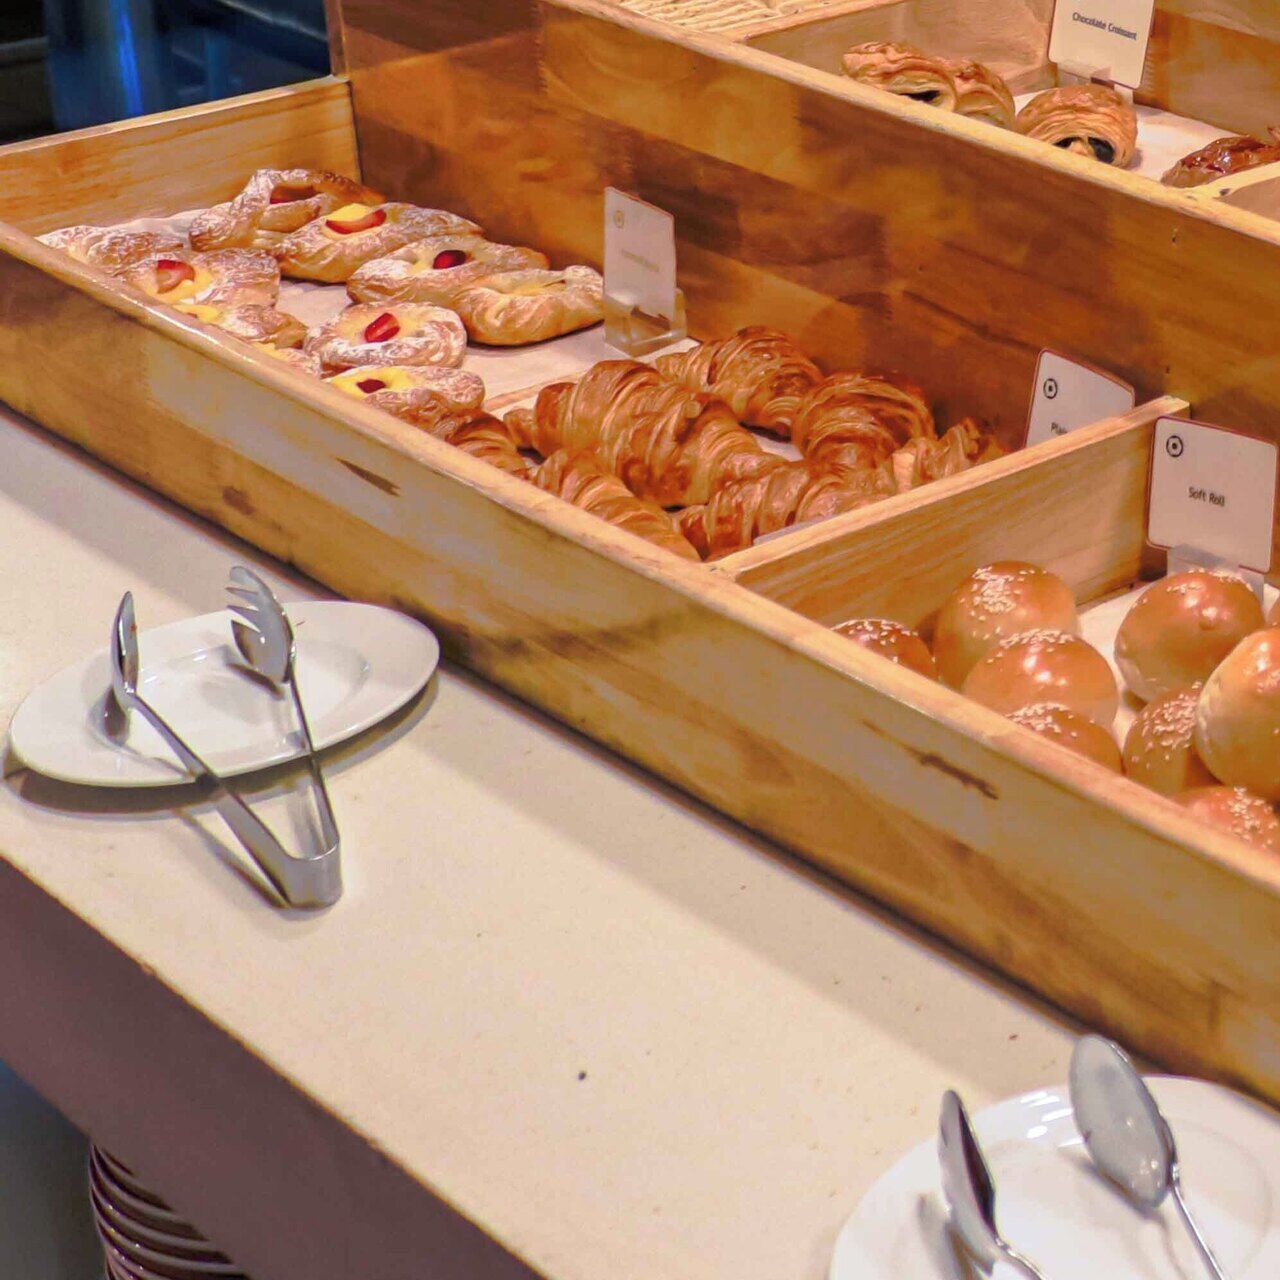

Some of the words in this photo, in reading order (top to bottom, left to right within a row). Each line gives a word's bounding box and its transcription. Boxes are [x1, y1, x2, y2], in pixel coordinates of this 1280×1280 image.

[1072, 12, 1107, 30] Chocolate
[1108, 23, 1137, 40] Croissant
[1188, 486, 1206, 502] Soft
[1209, 493, 1225, 507] Roll
